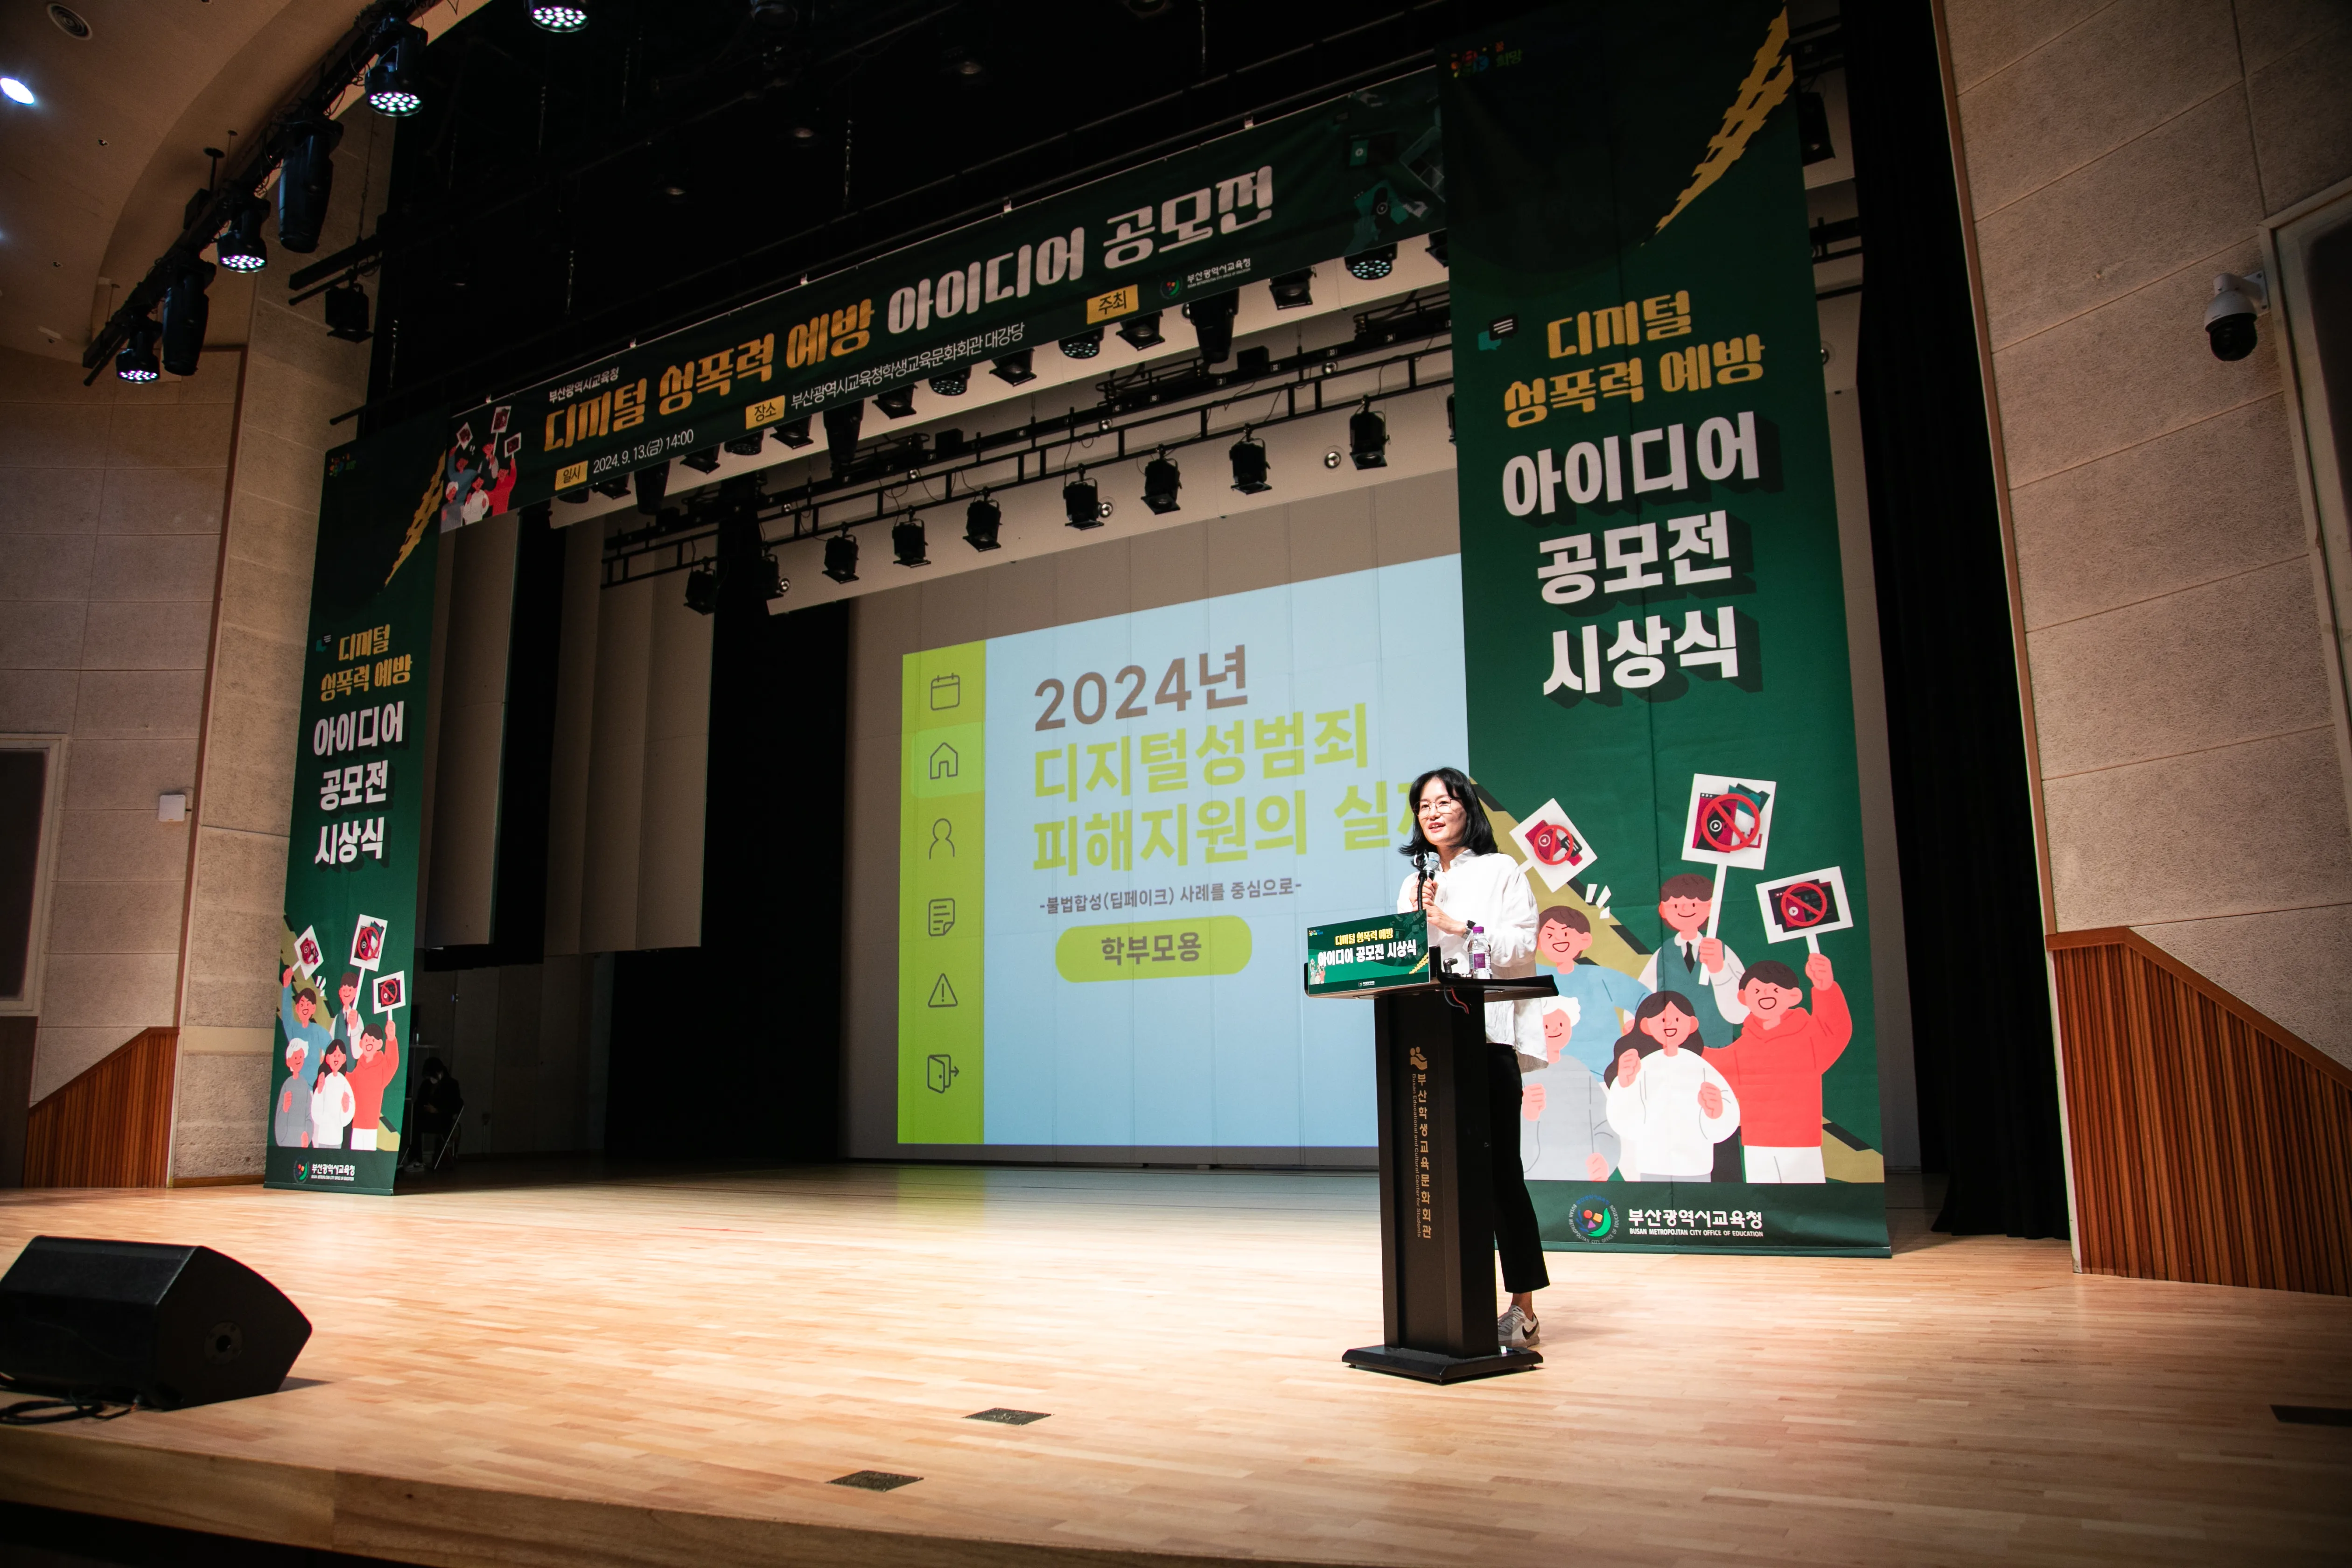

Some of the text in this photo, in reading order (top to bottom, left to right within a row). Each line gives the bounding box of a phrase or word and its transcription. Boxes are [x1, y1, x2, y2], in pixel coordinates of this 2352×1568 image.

[1187, 258, 1251, 283] 부산광역시교육청
[544, 165, 1273, 452] 디지털 성폭력 예방 아이디어 공모전
[1098, 290, 1127, 315] 주최
[1547, 290, 1692, 359] 디지털
[791, 322, 1025, 410] 부산광역시교육청학생교육문화회관 대강당
[1504, 333, 1766, 428] 성폭력 예방
[549, 367, 619, 403] 부산광역시교육청
[754, 403, 777, 421] 장소
[665, 429, 694, 450] 14:00
[562, 468, 581, 484] 일시
[1502, 411, 1759, 516] 아이디어
[1537, 510, 1732, 605] 공모전
[338, 624, 390, 661] 디지털
[1542, 606, 1739, 696] 시상식
[321, 653, 413, 702] 성폭력 예방
[1034, 644, 1248, 732] 2024년
[313, 701, 405, 756] 아이디어
[1035, 702, 1368, 803] 디지털성범죄
[320, 760, 389, 811] 공모전
[315, 817, 385, 865] 시상식
[1033, 789, 1307, 876] 피해지원의
[1180, 883, 1225, 903] 사례를
[1101, 932, 1202, 966] 학부모용
[1318, 939, 1416, 966] 아이디어 공모전 시상식
[1335, 928, 1393, 945] 디지털 성폭력 예방
[311, 1163, 355, 1176] 부산광역시교육청
[1568, 1204, 1577, 1218] BUSAN
[1610, 1204, 1619, 1228] EDUCATION
[1628, 1209, 1763, 1230] 부산광역시교육청
[1568, 1219, 1590, 1243] METROPOLITAN
[1601, 1233, 1614, 1243] OFFICE
